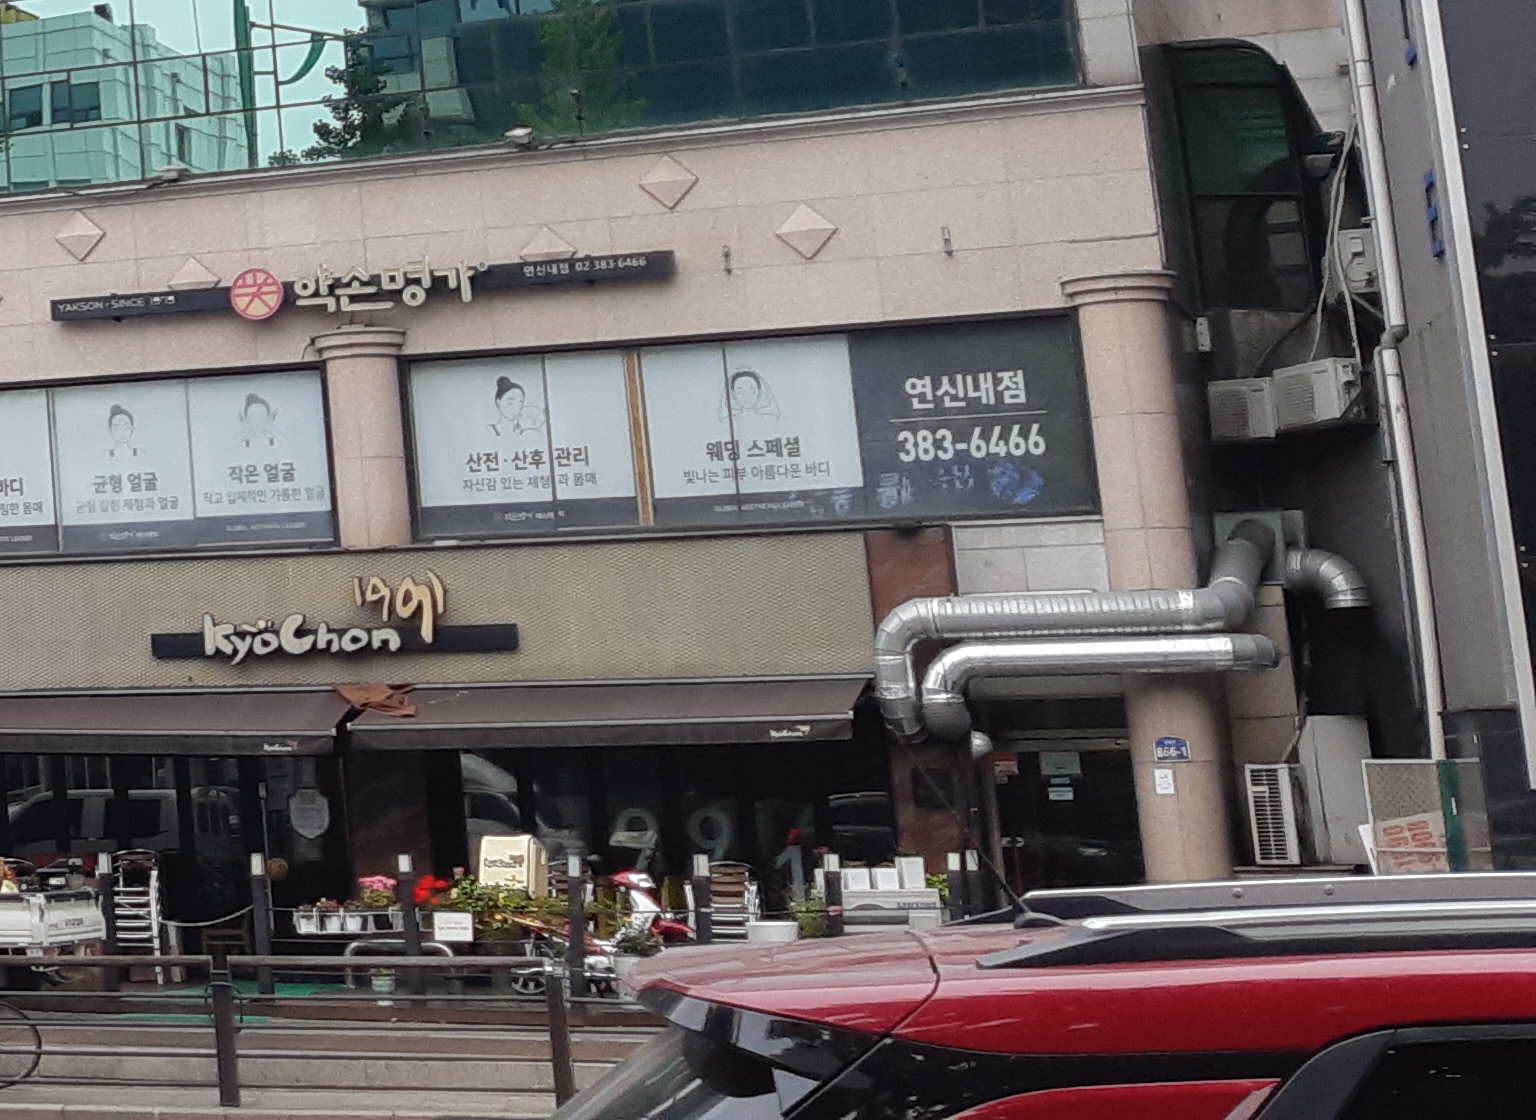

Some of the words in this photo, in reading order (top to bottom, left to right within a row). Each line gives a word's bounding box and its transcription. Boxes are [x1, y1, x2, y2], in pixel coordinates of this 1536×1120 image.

[293, 259, 475, 311] 약손명가
[903, 368, 1029, 412] 연신내점
[705, 439, 741, 462] 웨딩
[746, 435, 802, 459] 스페셜
[897, 421, 1047, 465] 383-6466
[554, 445, 590, 468] 관리
[804, 460, 831, 478] 바디
[92, 474, 124, 494] 균형
[127, 471, 158, 492] 얼굴
[227, 464, 260, 484] 작은
[263, 461, 296, 482] 얼굴
